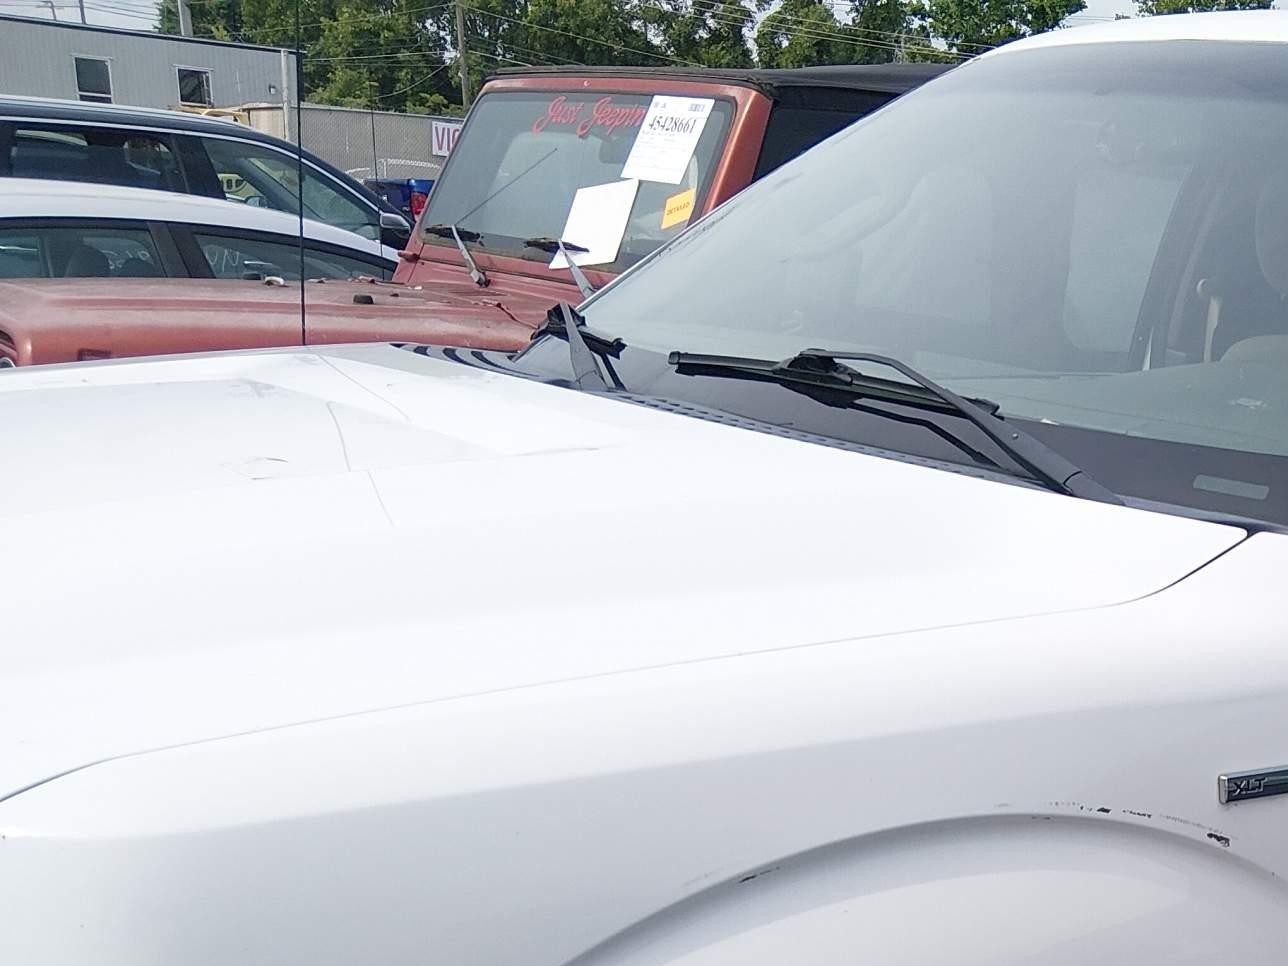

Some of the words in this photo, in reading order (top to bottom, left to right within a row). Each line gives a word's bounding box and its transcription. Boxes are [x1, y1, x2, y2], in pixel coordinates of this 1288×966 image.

[531, 95, 585, 136] Just
[648, 115, 697, 134] 45428661
[1231, 776, 1268, 797] XLT
